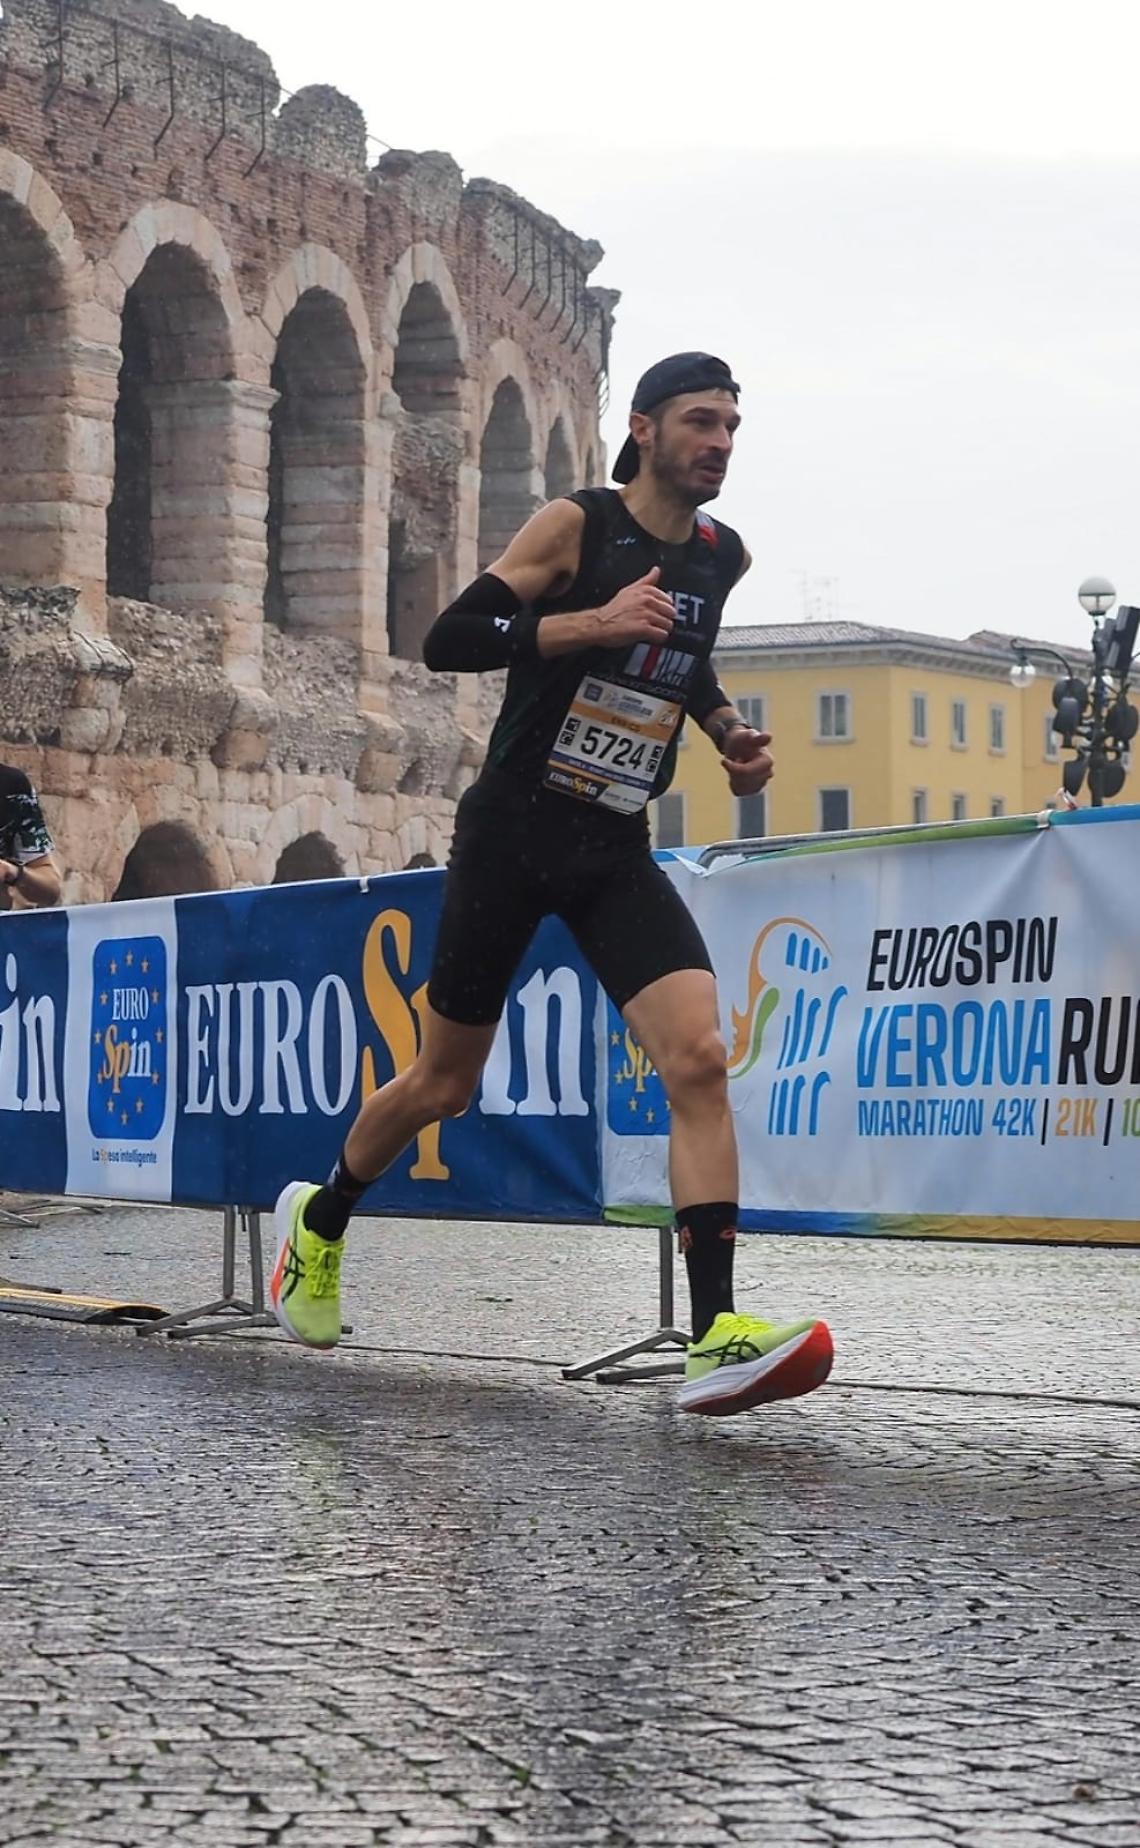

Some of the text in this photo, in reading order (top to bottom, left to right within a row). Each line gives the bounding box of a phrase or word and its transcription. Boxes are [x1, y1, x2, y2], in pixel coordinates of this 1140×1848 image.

[667, 591, 704, 624] ET
[580, 725, 646, 770] 5724
[866, 917, 1058, 991] EUROSPIN
[112, 988, 149, 1021] EURO
[103, 1024, 152, 1093] Spin
[858, 1099, 983, 1136] MARATHON
[992, 1098, 1036, 1136] 42K
[1055, 1098, 1098, 1136] 21K
